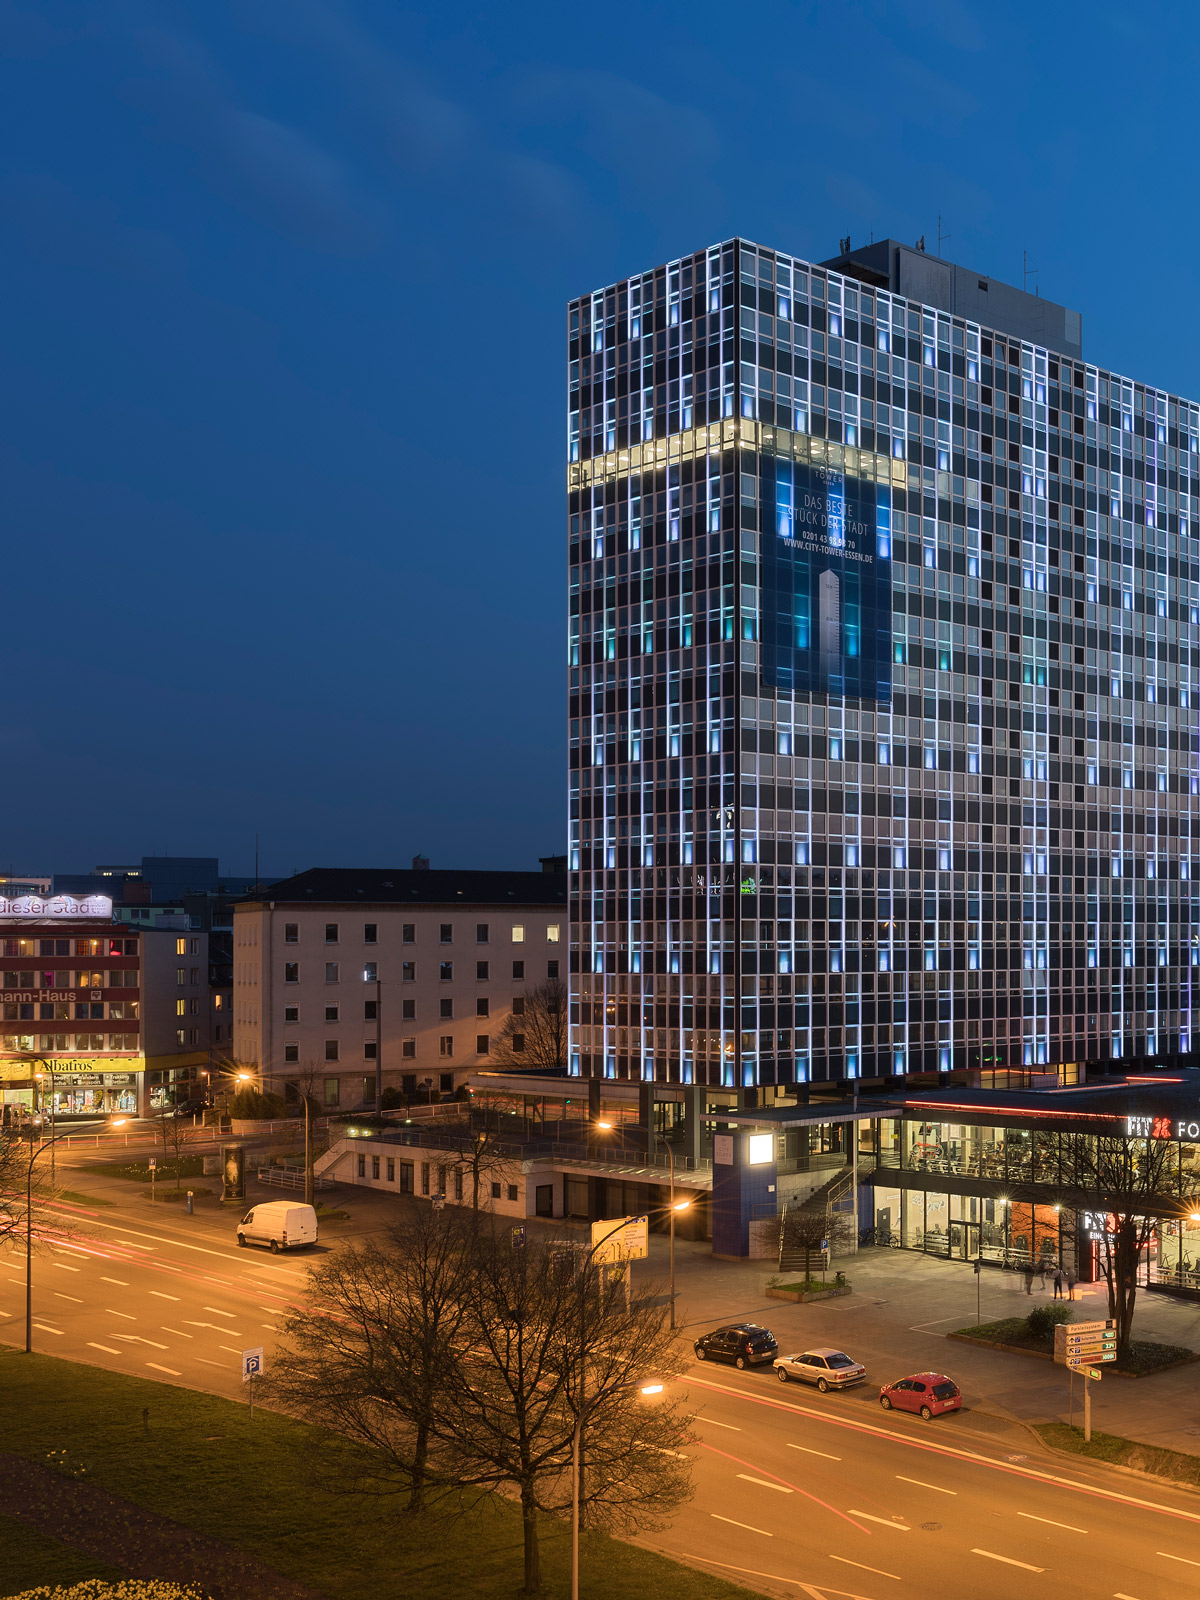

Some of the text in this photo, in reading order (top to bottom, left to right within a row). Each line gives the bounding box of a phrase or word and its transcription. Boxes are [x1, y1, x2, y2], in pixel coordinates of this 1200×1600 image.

[814, 470, 843, 483] TOWER
[804, 494, 853, 517] DAS BESTE
[787, 507, 868, 537] STÜCK DER STADT
[783, 538, 873, 564] WWW.CITY-TOWER-ESSEN.DE
[802, 530, 818, 541] 0201
[819, 535, 828, 543] 43
[828, 536, 837, 546] 98
[847, 541, 856, 549] 70
[39, 1060, 93, 1072] Albatros
[1127, 1115, 1172, 1139] FITX
